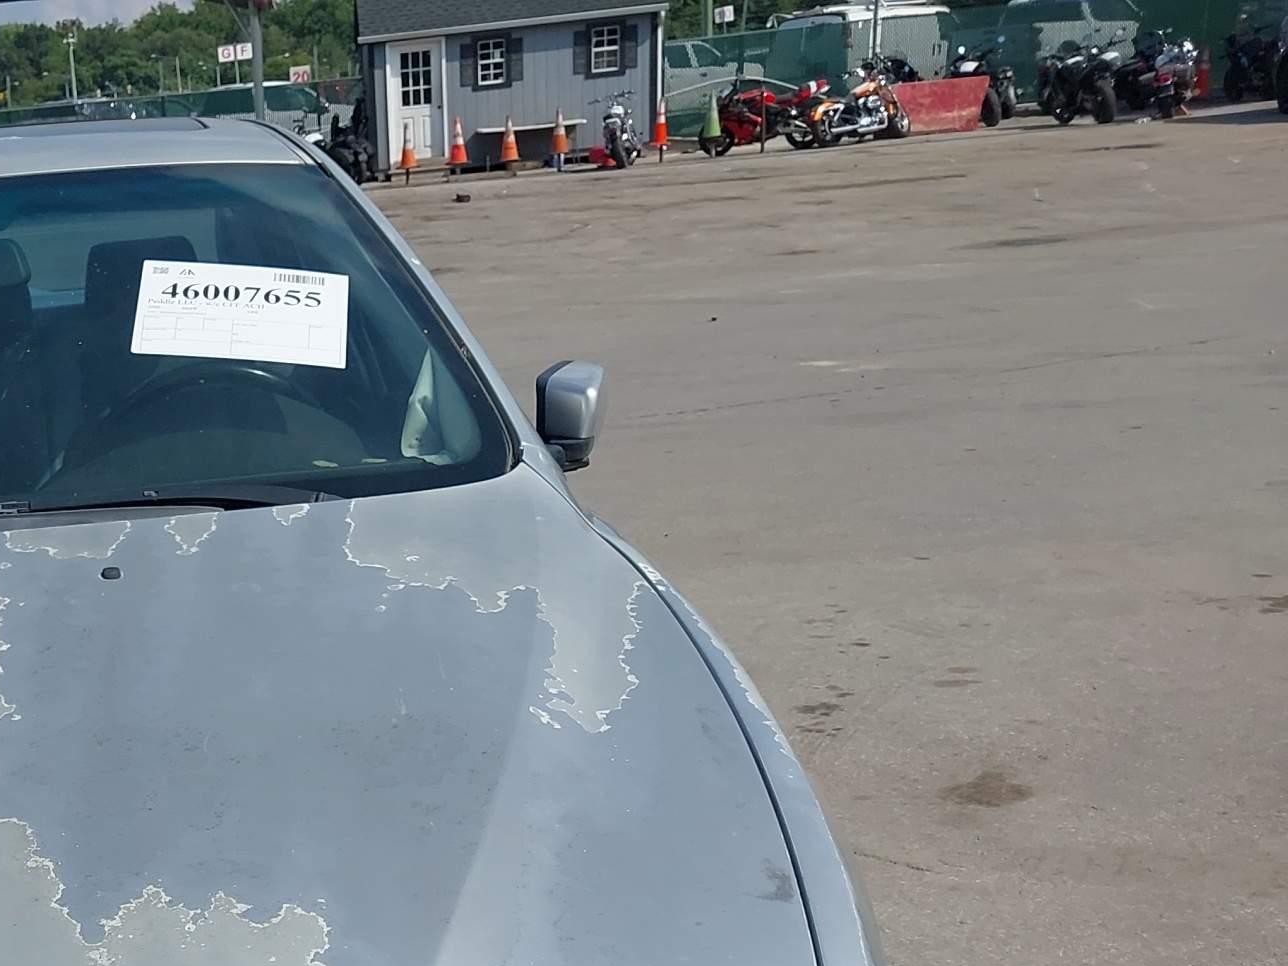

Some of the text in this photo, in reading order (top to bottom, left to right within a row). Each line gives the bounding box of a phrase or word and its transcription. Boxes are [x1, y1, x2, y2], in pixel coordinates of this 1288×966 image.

[221, 48, 231, 59] G
[240, 45, 248, 57] F
[292, 70, 310, 83] 20
[161, 282, 322, 309] 46007655
